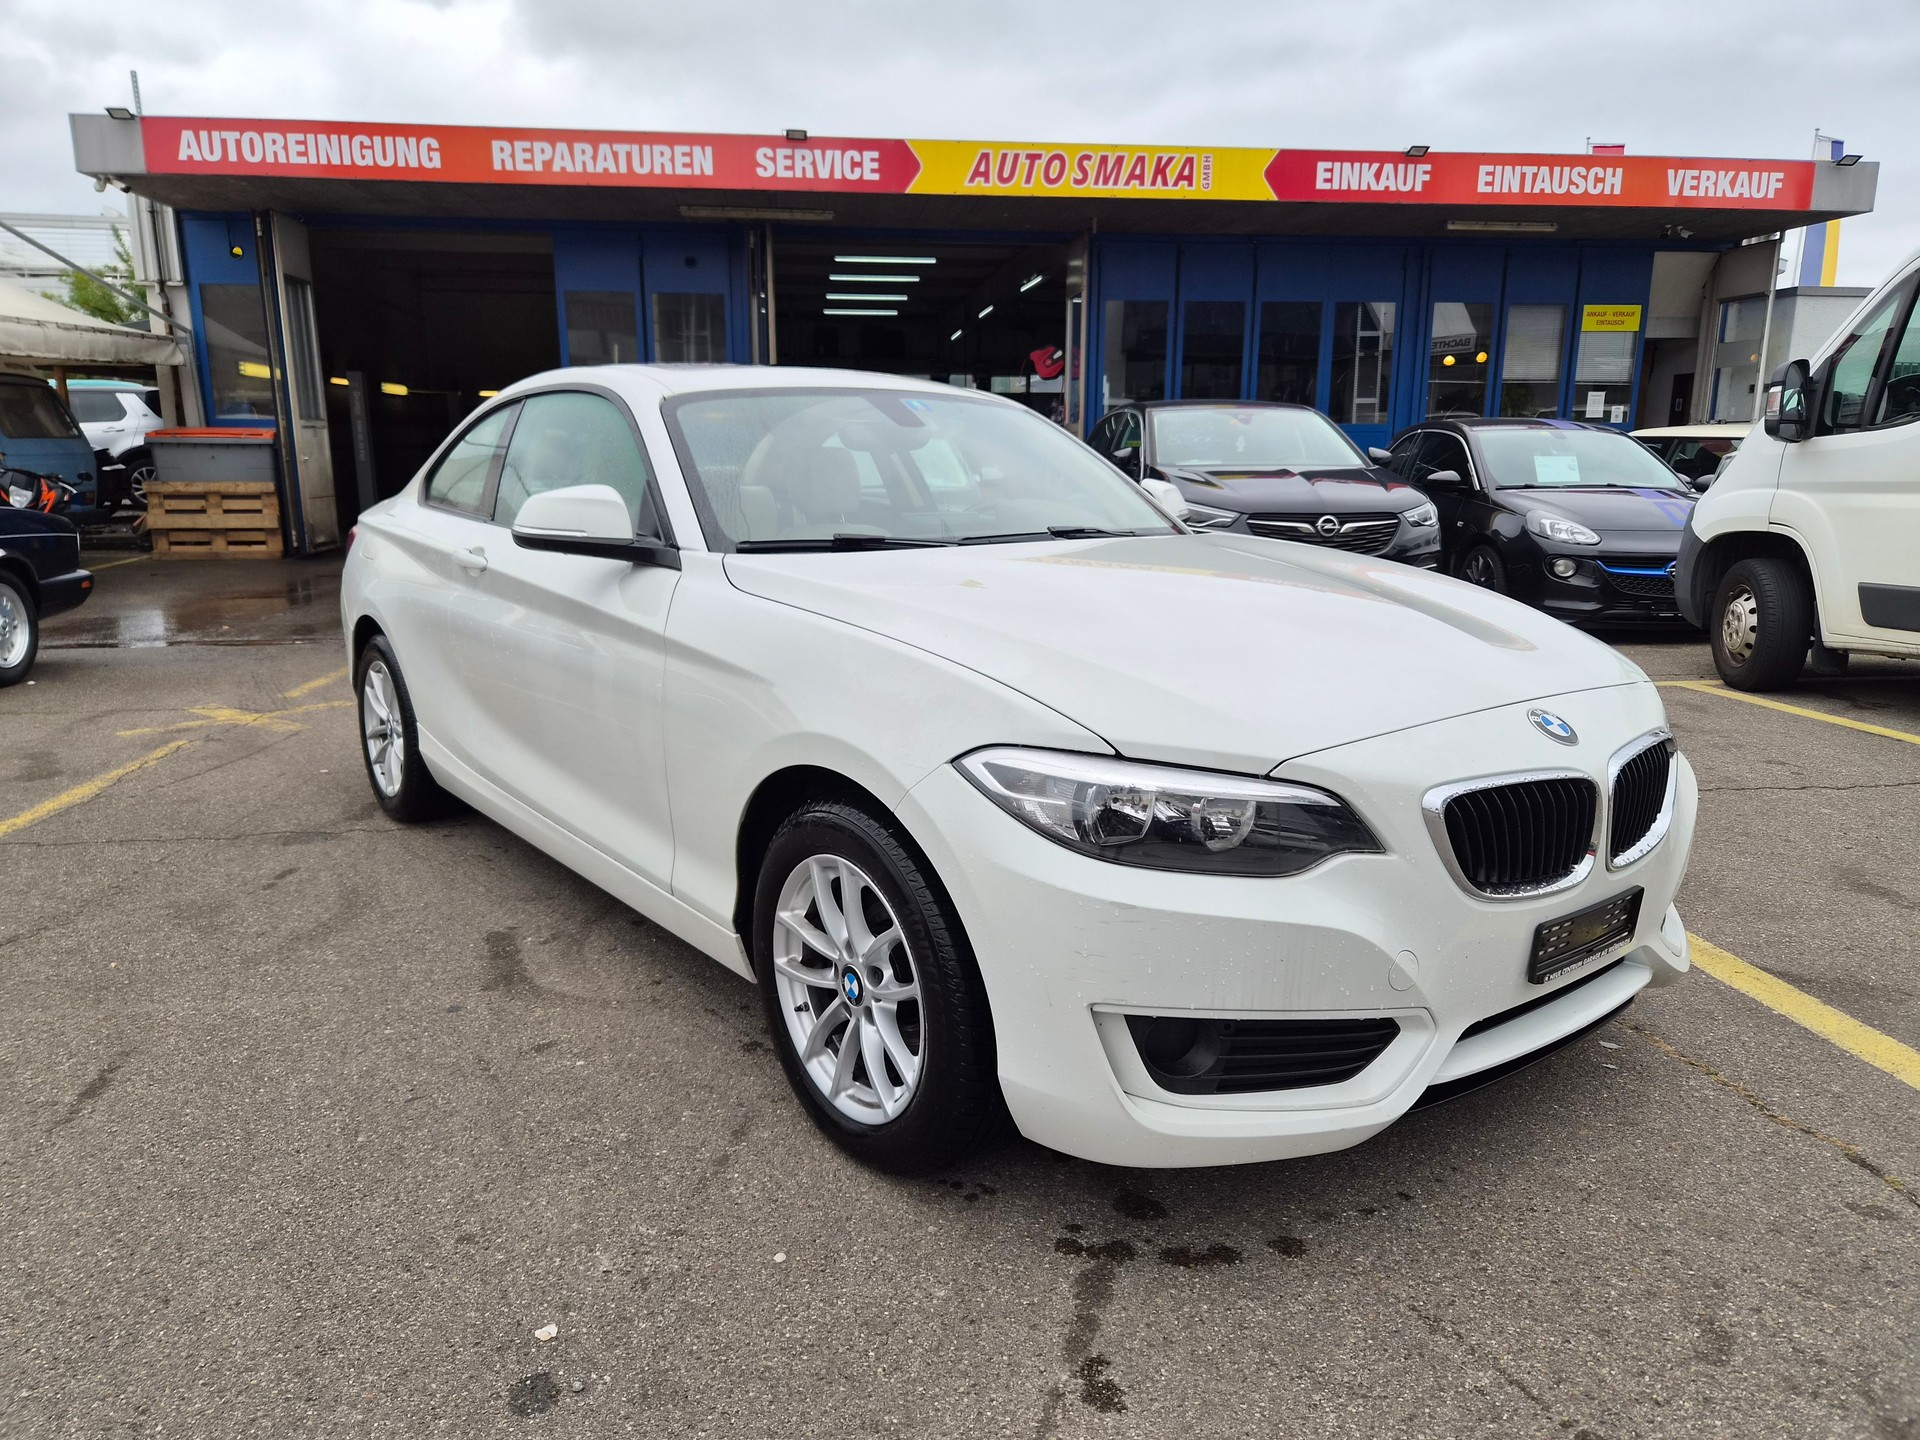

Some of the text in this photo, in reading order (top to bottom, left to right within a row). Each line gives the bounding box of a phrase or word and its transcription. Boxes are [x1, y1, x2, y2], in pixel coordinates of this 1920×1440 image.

[178, 129, 442, 169] AUTOREINIGUNG
[491, 140, 714, 176] REPARATUREN
[756, 147, 880, 181] SERVICE
[966, 151, 1196, 188] AUTO SMAKA
[1202, 155, 1211, 190] GMBH
[1315, 161, 1432, 192] EINKAUF
[1477, 165, 1623, 195] EINTAUSCH
[1667, 169, 1784, 199] VERKAUF
